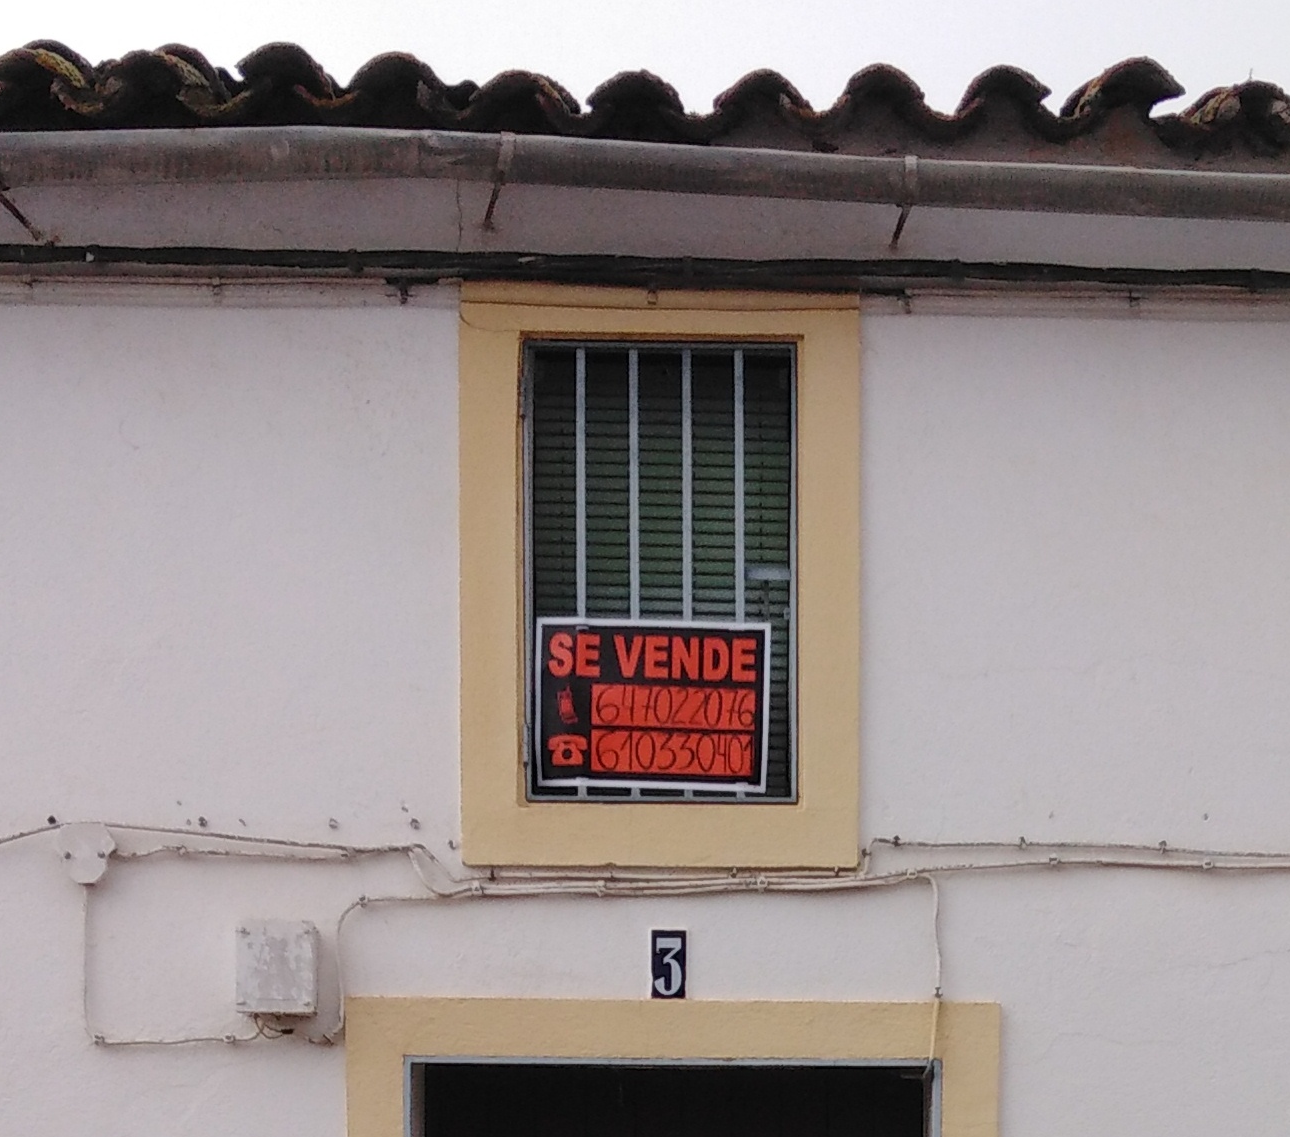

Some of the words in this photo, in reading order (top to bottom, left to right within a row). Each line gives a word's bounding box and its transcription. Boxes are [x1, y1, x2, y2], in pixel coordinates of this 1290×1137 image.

[547, 632, 601, 678] SE
[613, 634, 757, 682] VENDE
[595, 685, 754, 727] 647022076
[595, 731, 753, 774] 610330401
[654, 937, 682, 996] 3
